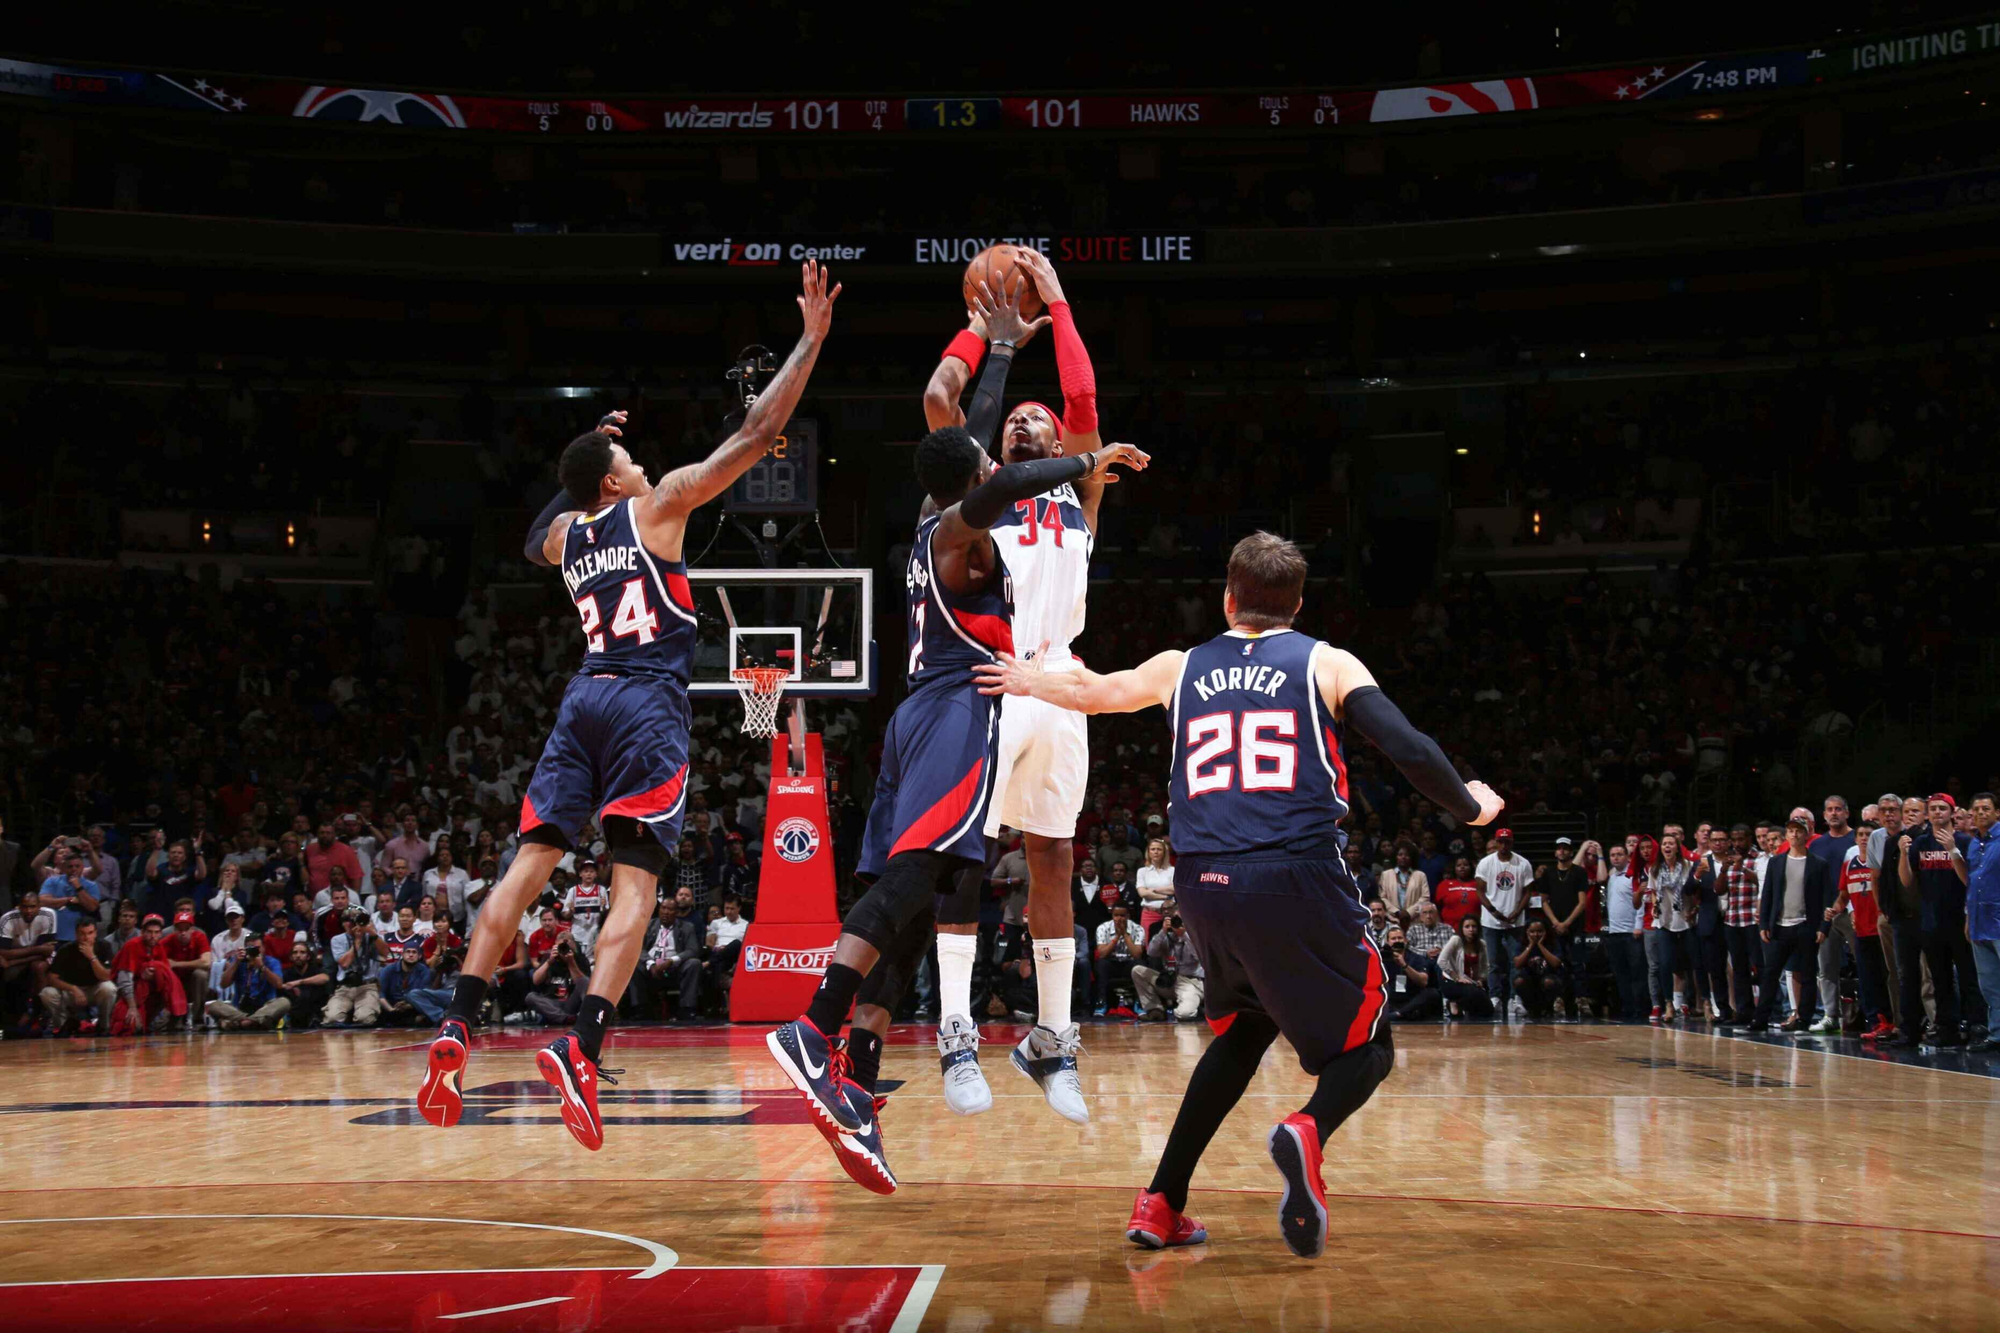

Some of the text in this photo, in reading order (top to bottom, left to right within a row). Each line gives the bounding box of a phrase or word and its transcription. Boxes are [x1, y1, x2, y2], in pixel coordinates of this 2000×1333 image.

[1851, 28, 1967, 71] IGNITING
[1692, 66, 1777, 92] 7:48 PM
[527, 102, 560, 115] FOULS
[590, 102, 609, 115] TOL
[865, 101, 888, 115] QTR
[1025, 99, 1083, 128] 101
[1130, 103, 1200, 123] HAWKS
[1259, 96, 1290, 110] FOULS
[1318, 95, 1336, 108] TOL
[538, 116, 550, 132] 5
[664, 102, 775, 129] wizards
[783, 101, 840, 130] 101
[870, 115, 883, 131] 4
[932, 101, 977, 128] 1.3
[1269, 109, 1281, 125] 5
[673, 237, 866, 265] verizon Center
[1060, 237, 1130, 262] SUITE
[1141, 237, 1191, 262] LIFE
[1015, 498, 1065, 549] 34
[565, 546, 639, 593] BAZEMORE
[576, 575, 661, 655] 24
[1193, 665, 1288, 702] KORVER
[1186, 709, 1298, 800] 26
[776, 785, 815, 795] SPALDING
[1199, 871, 1230, 886] HAWKS
